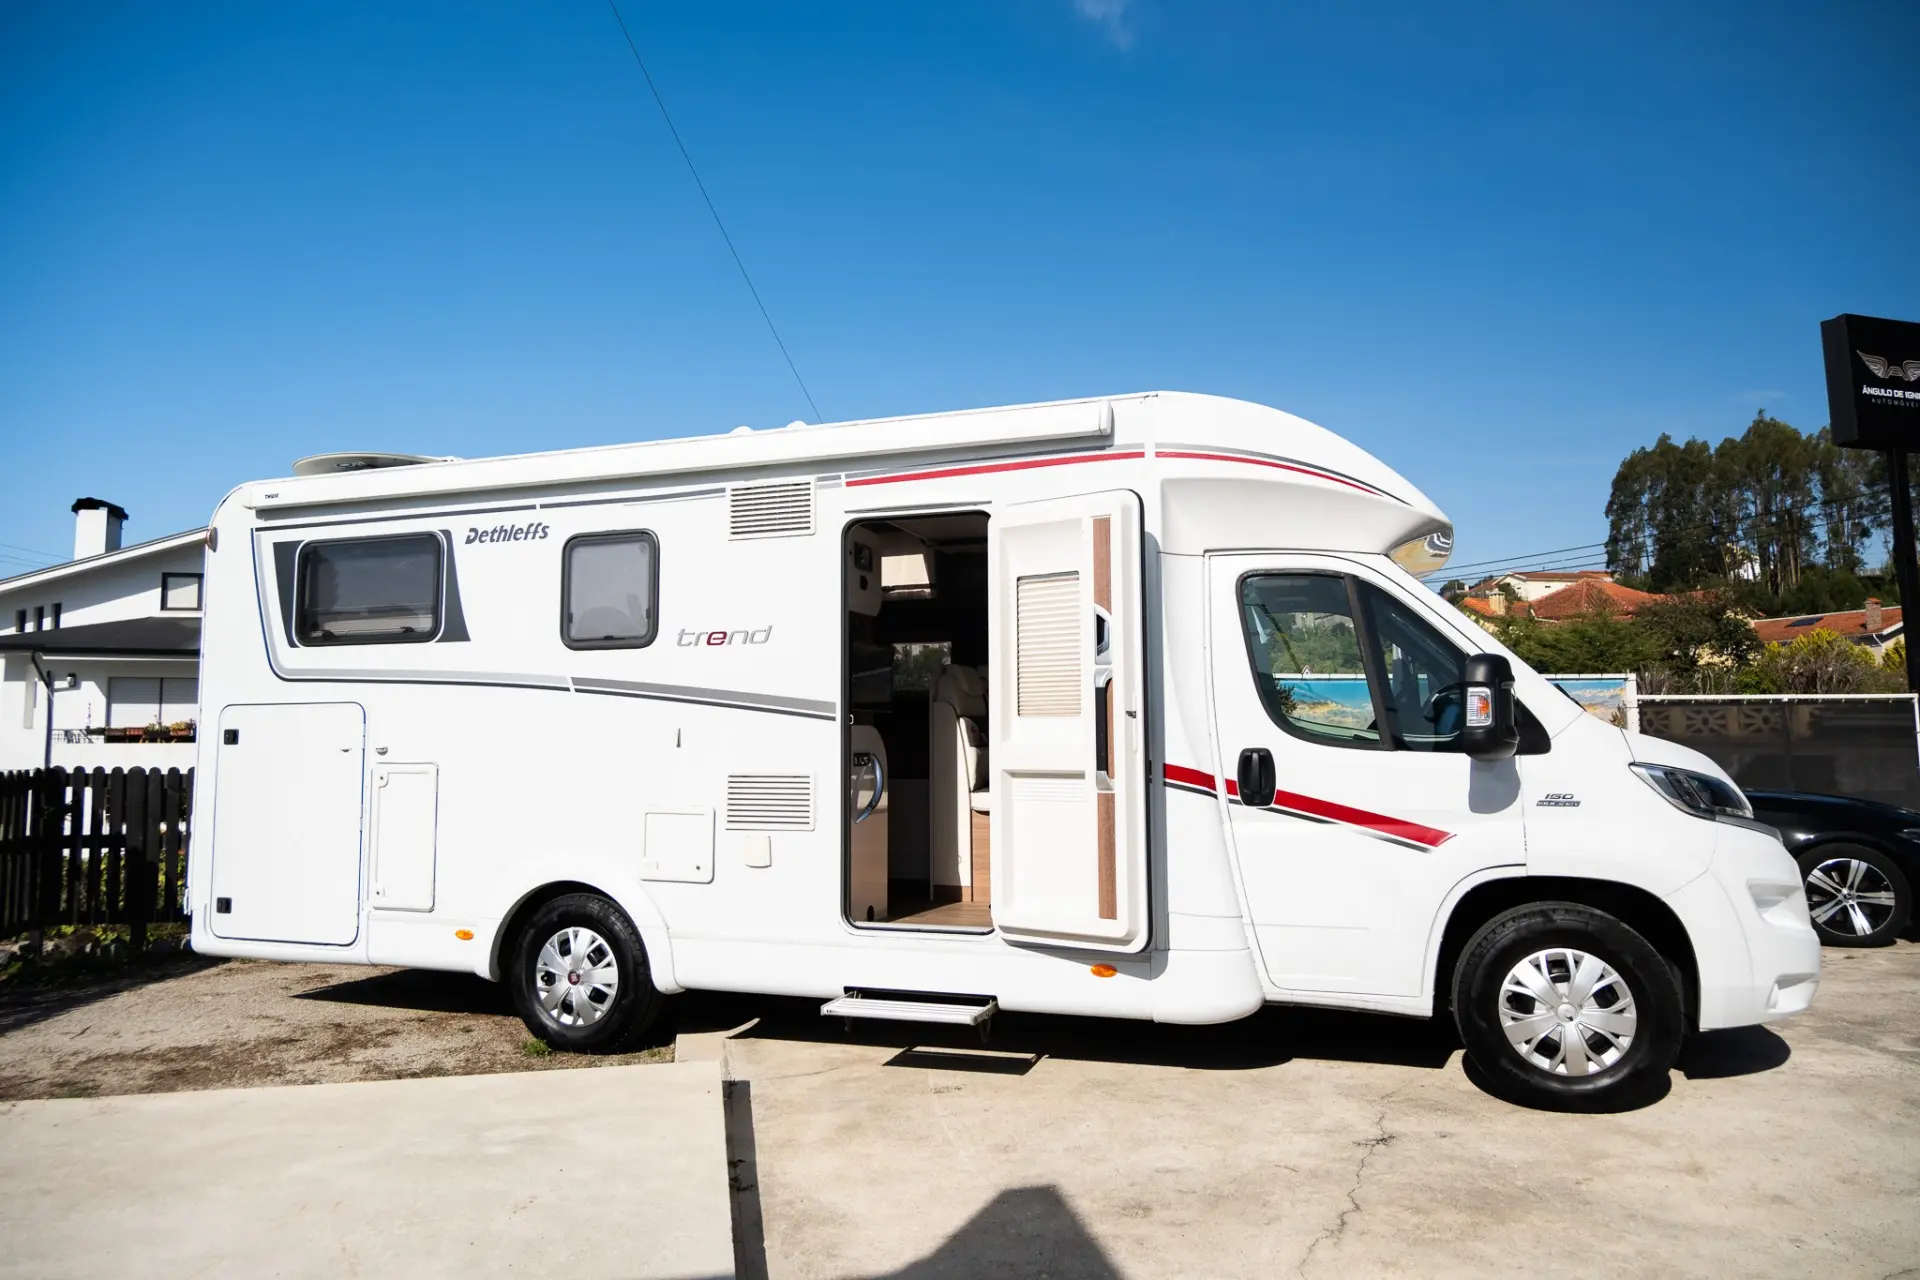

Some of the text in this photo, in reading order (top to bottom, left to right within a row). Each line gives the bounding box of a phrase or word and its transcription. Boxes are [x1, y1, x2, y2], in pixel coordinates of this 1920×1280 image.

[1871, 397, 1920, 407] AUTOMÓVEI
[1893, 389, 1904, 398] DE
[1905, 391, 1920, 400] IGNI
[465, 522, 550, 545] Dethleffs
[677, 625, 773, 647] trend
